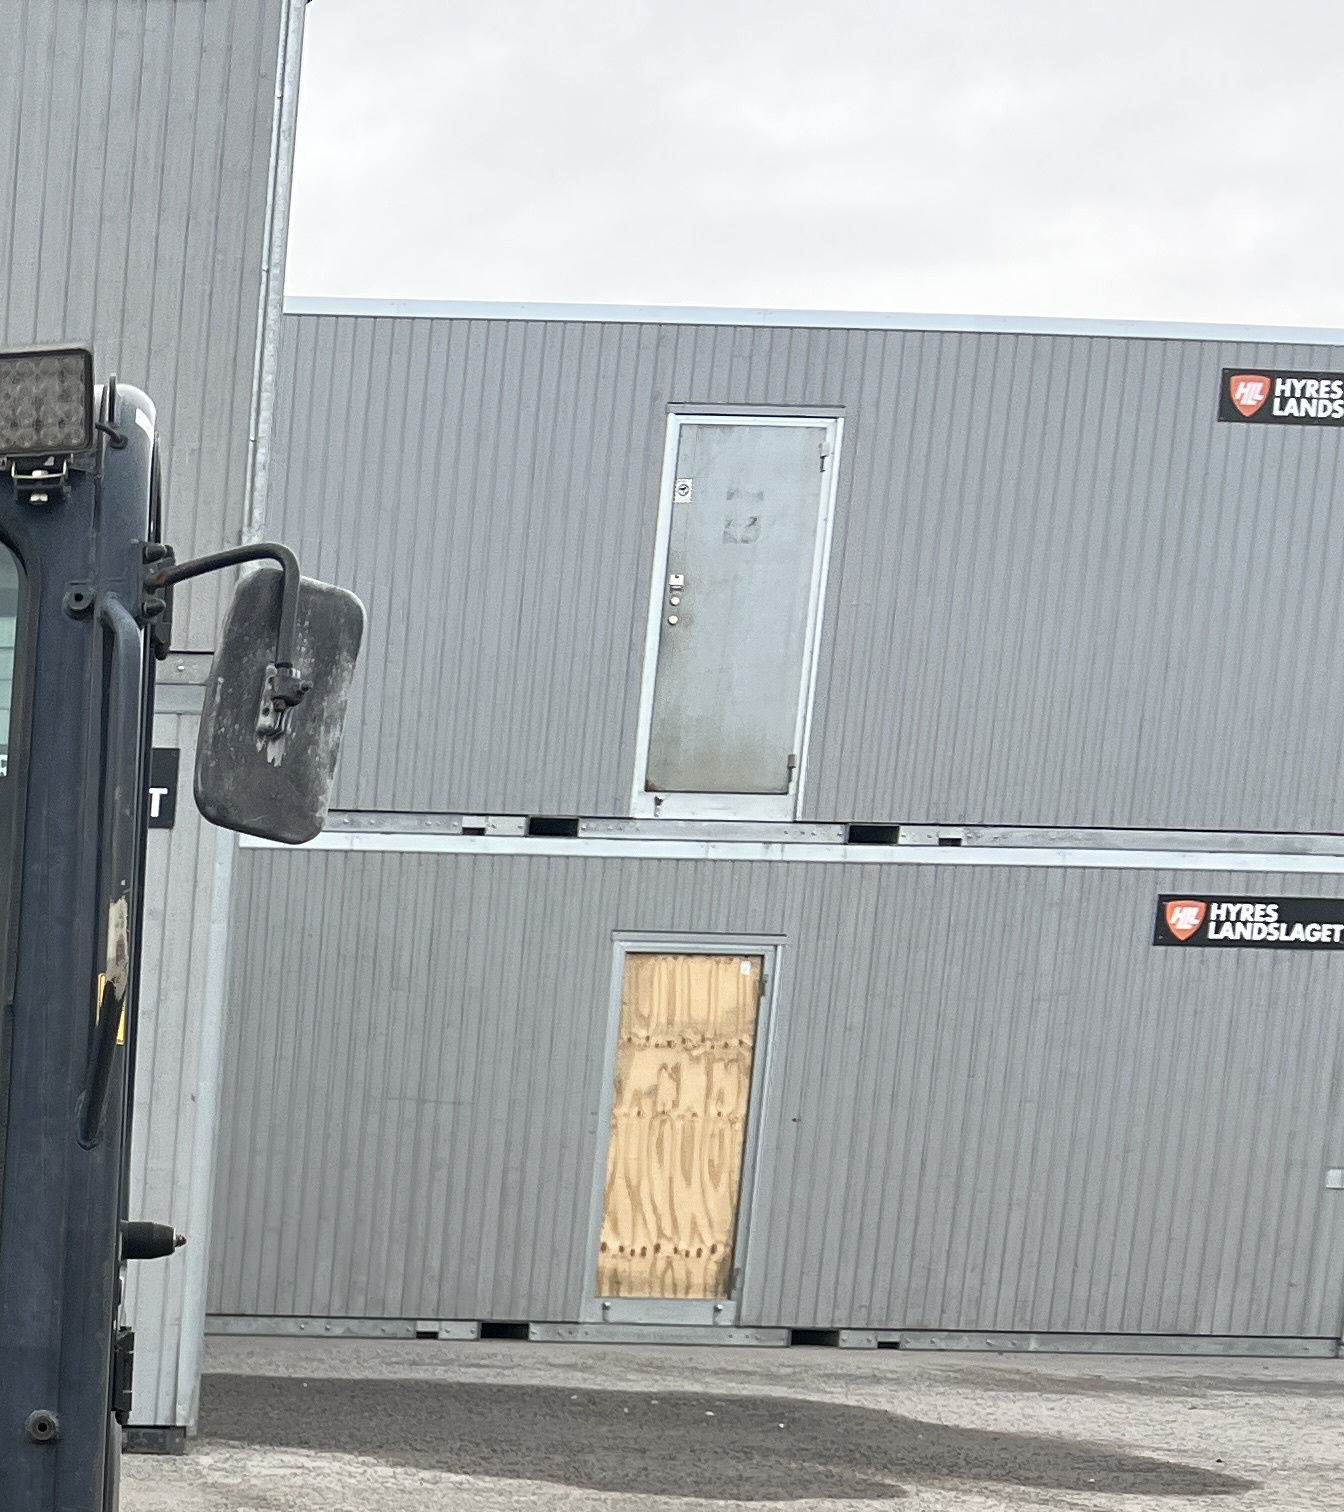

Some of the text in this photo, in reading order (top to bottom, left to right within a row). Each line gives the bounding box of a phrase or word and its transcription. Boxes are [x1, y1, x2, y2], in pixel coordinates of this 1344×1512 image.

[1274, 378, 1344, 399] HYRES
[1273, 397, 1344, 419] LANDS
[1210, 903, 1279, 922] HYRES
[1208, 922, 1344, 942] LANDSLAGET
